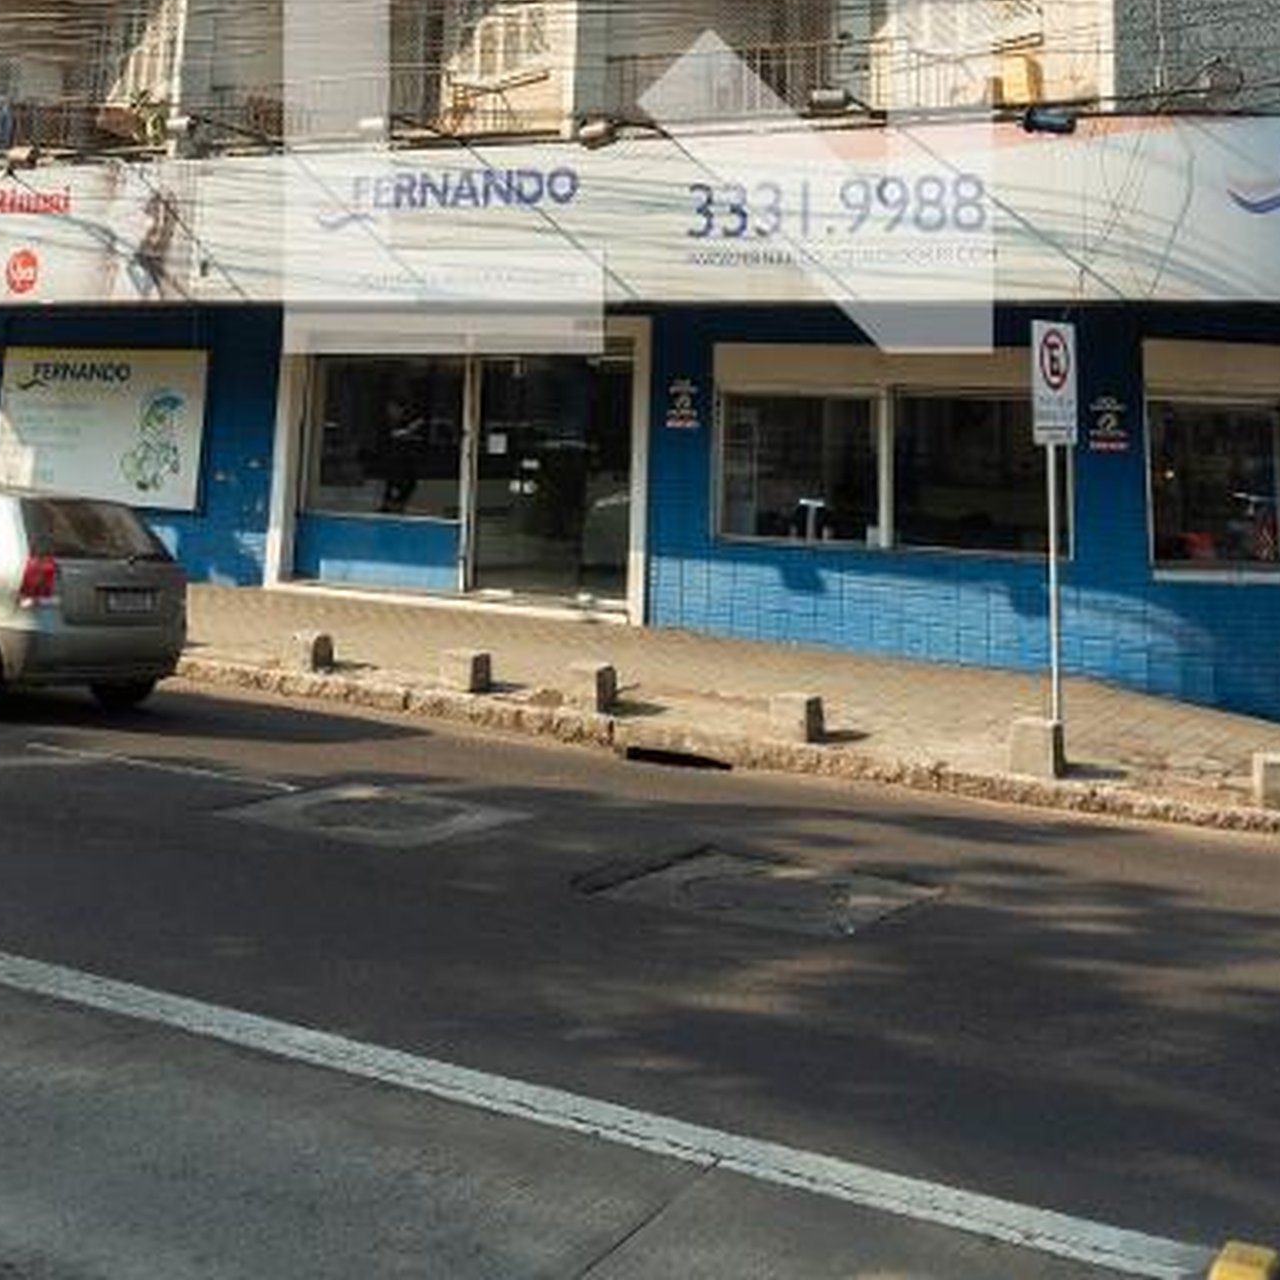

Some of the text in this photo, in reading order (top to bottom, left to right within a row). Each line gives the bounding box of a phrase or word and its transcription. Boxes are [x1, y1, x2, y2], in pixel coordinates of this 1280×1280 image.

[353, 167, 580, 211] FERNANDO
[686, 174, 988, 239] 3331.9988
[33, 362, 131, 382] FERNANDO
